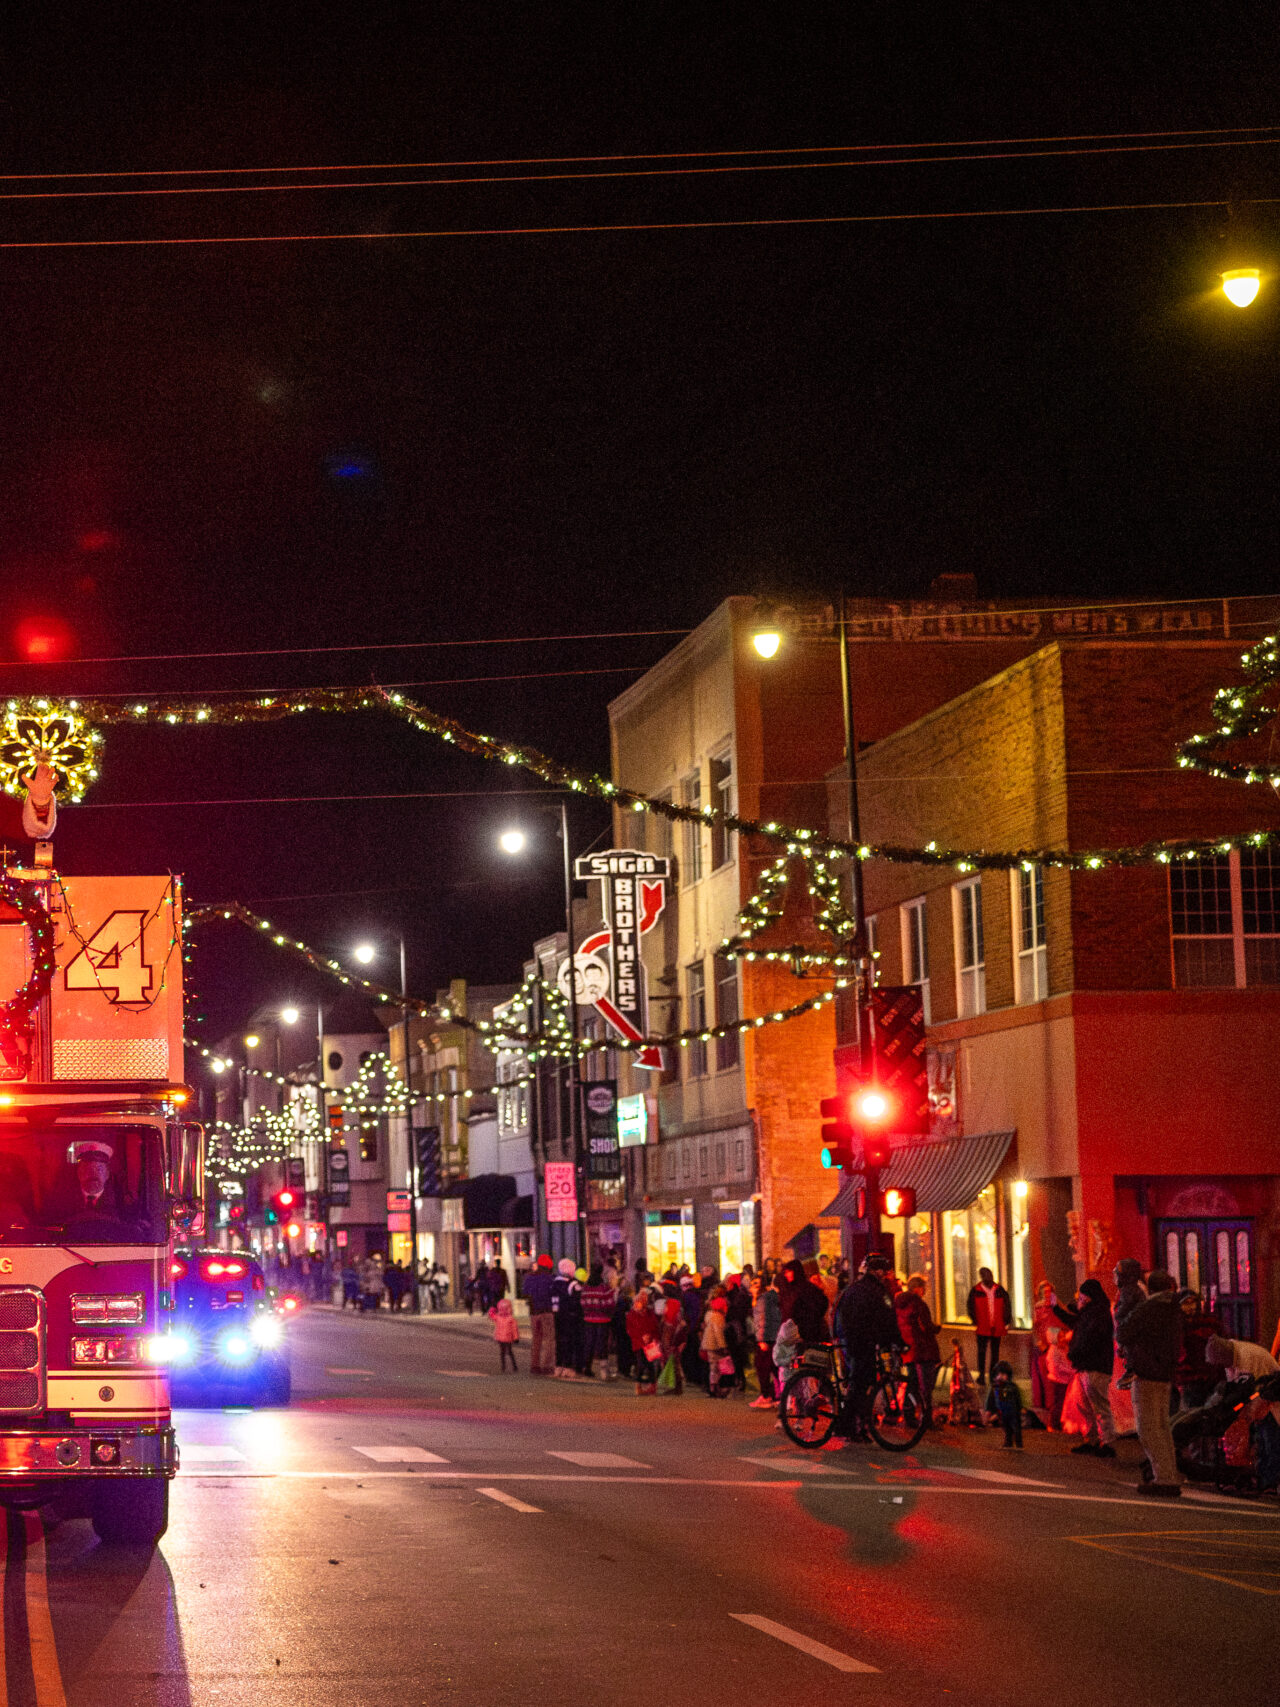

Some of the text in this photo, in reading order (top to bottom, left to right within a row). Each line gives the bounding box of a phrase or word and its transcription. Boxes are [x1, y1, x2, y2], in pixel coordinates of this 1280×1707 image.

[591, 857, 655, 874] SIGN
[64, 909, 153, 1004] 4
[614, 878, 637, 1012] BROTHERS
[549, 1181, 572, 1194] 20
